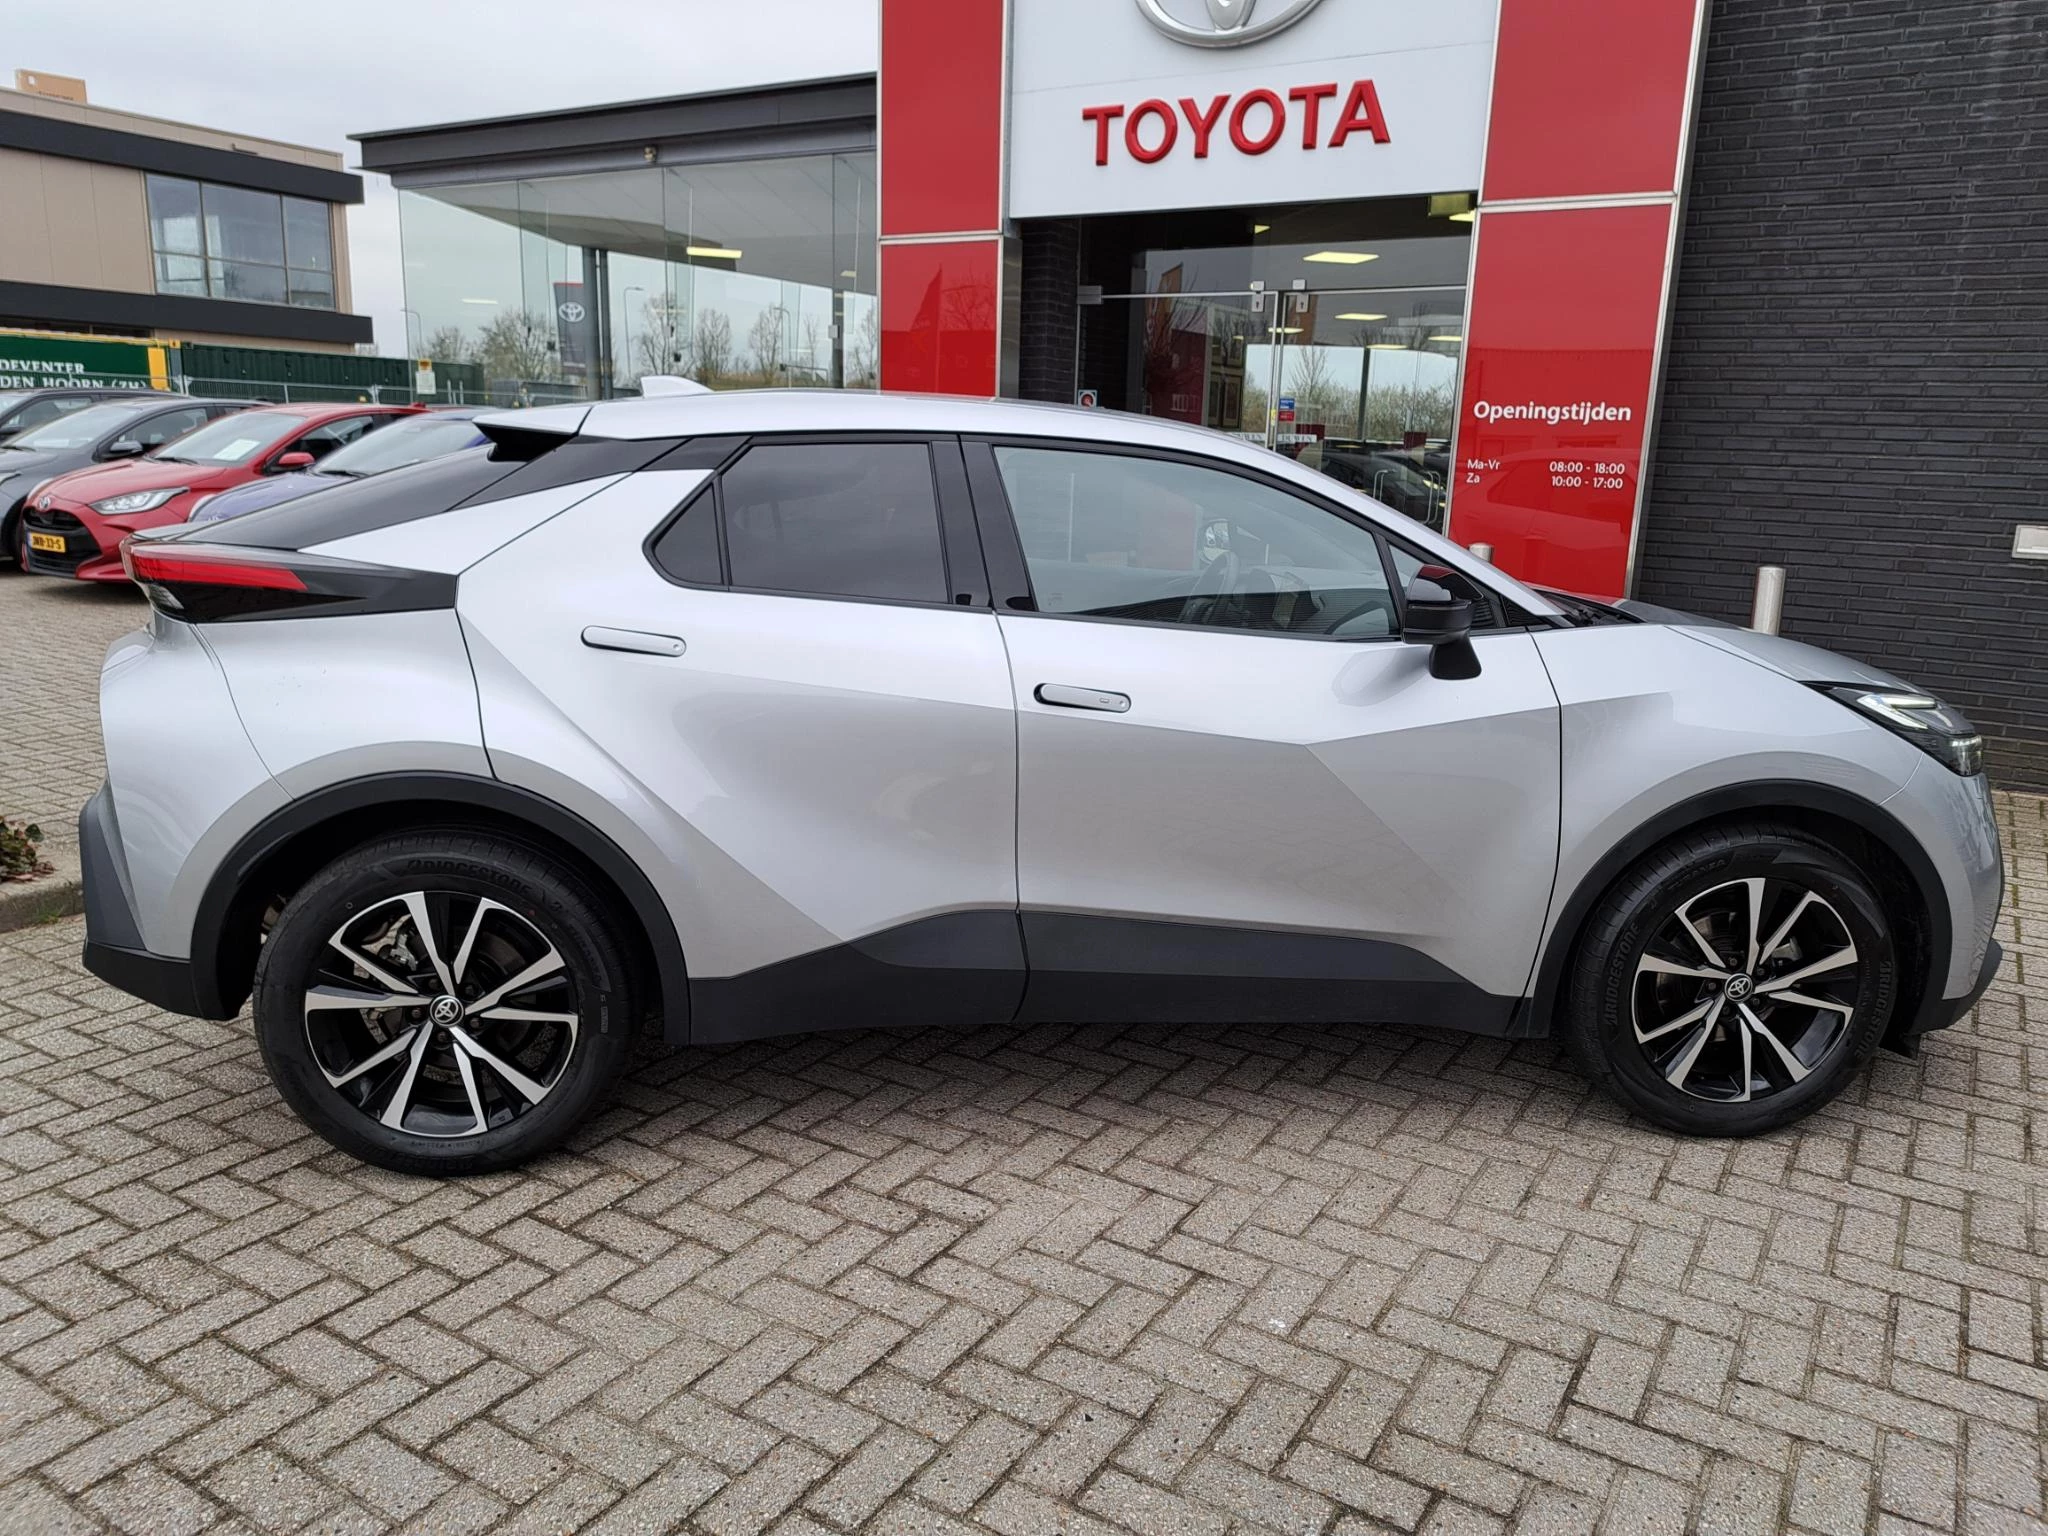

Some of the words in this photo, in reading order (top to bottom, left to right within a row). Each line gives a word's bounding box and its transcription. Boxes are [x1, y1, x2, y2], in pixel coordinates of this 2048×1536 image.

[1082, 78, 1391, 166] TOYOTA
[0, 358, 85, 374] DEVENTER
[0, 375, 34, 388] DEN
[1473, 400, 1631, 425] Openingstijden
[1467, 459, 1500, 470] Ma-Vr
[1549, 461, 1583, 473] 08:00
[1595, 463, 1625, 475] 18:00
[1466, 472, 1480, 484] Za
[1552, 476, 1582, 488] 10:00
[1593, 478, 1624, 489] 17:00
[1603, 921, 1641, 1026] BRIDGESTONE
[1854, 960, 1894, 1058] BRIDGESTONE
